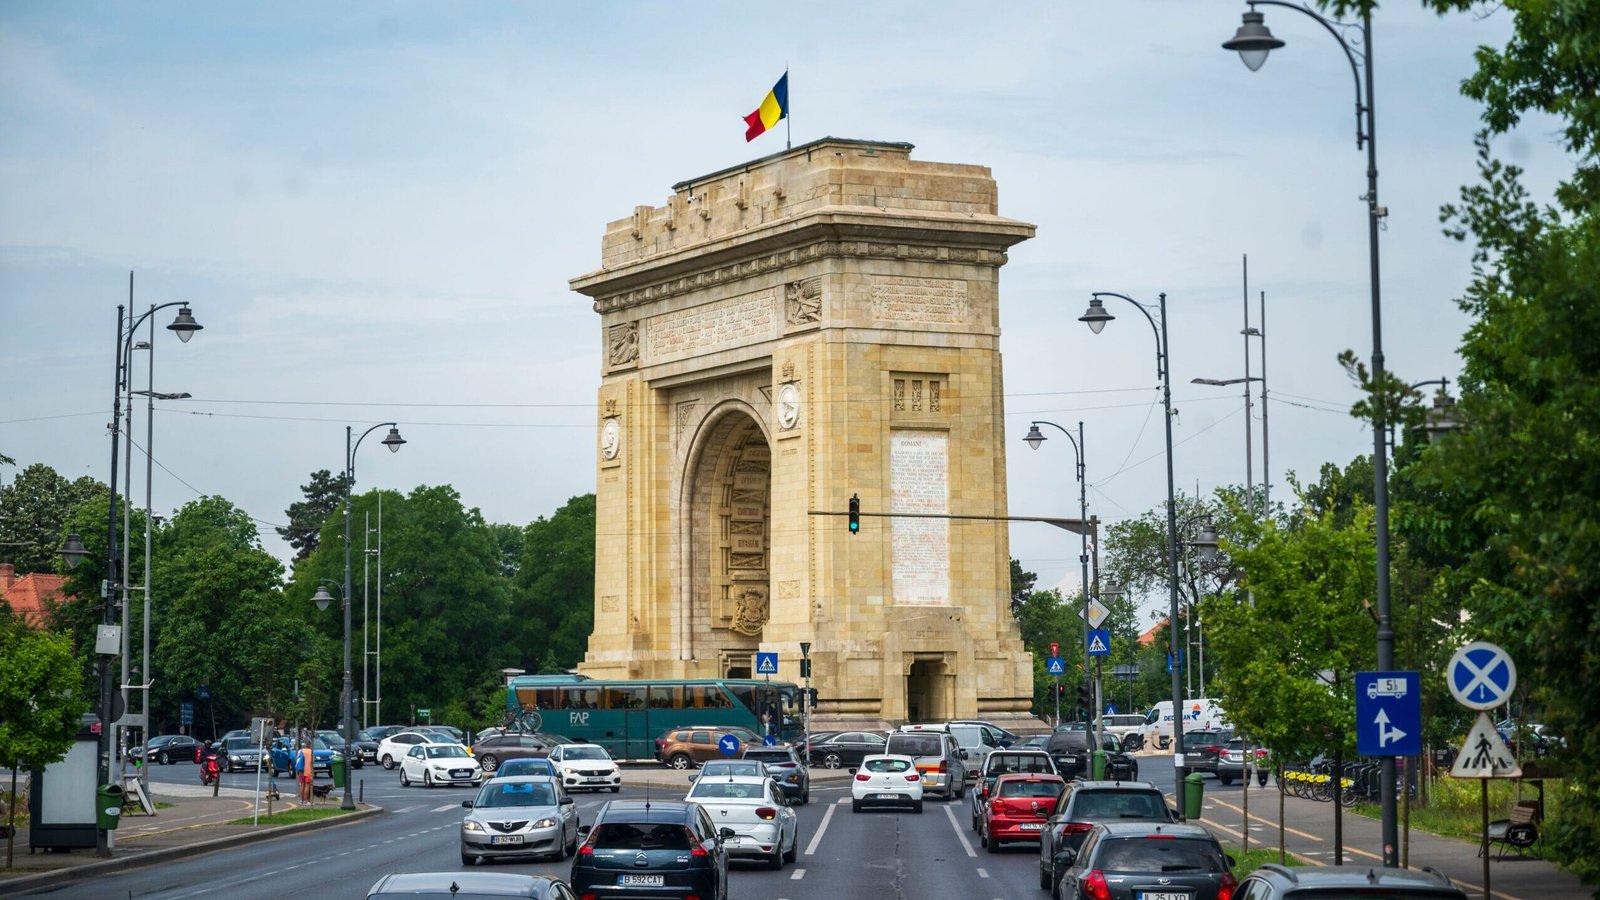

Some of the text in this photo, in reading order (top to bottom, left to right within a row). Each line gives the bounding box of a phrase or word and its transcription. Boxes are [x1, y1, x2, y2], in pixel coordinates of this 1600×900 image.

[570, 711, 590, 724] FAP
[624, 875, 662, 884] B 592 CAT
